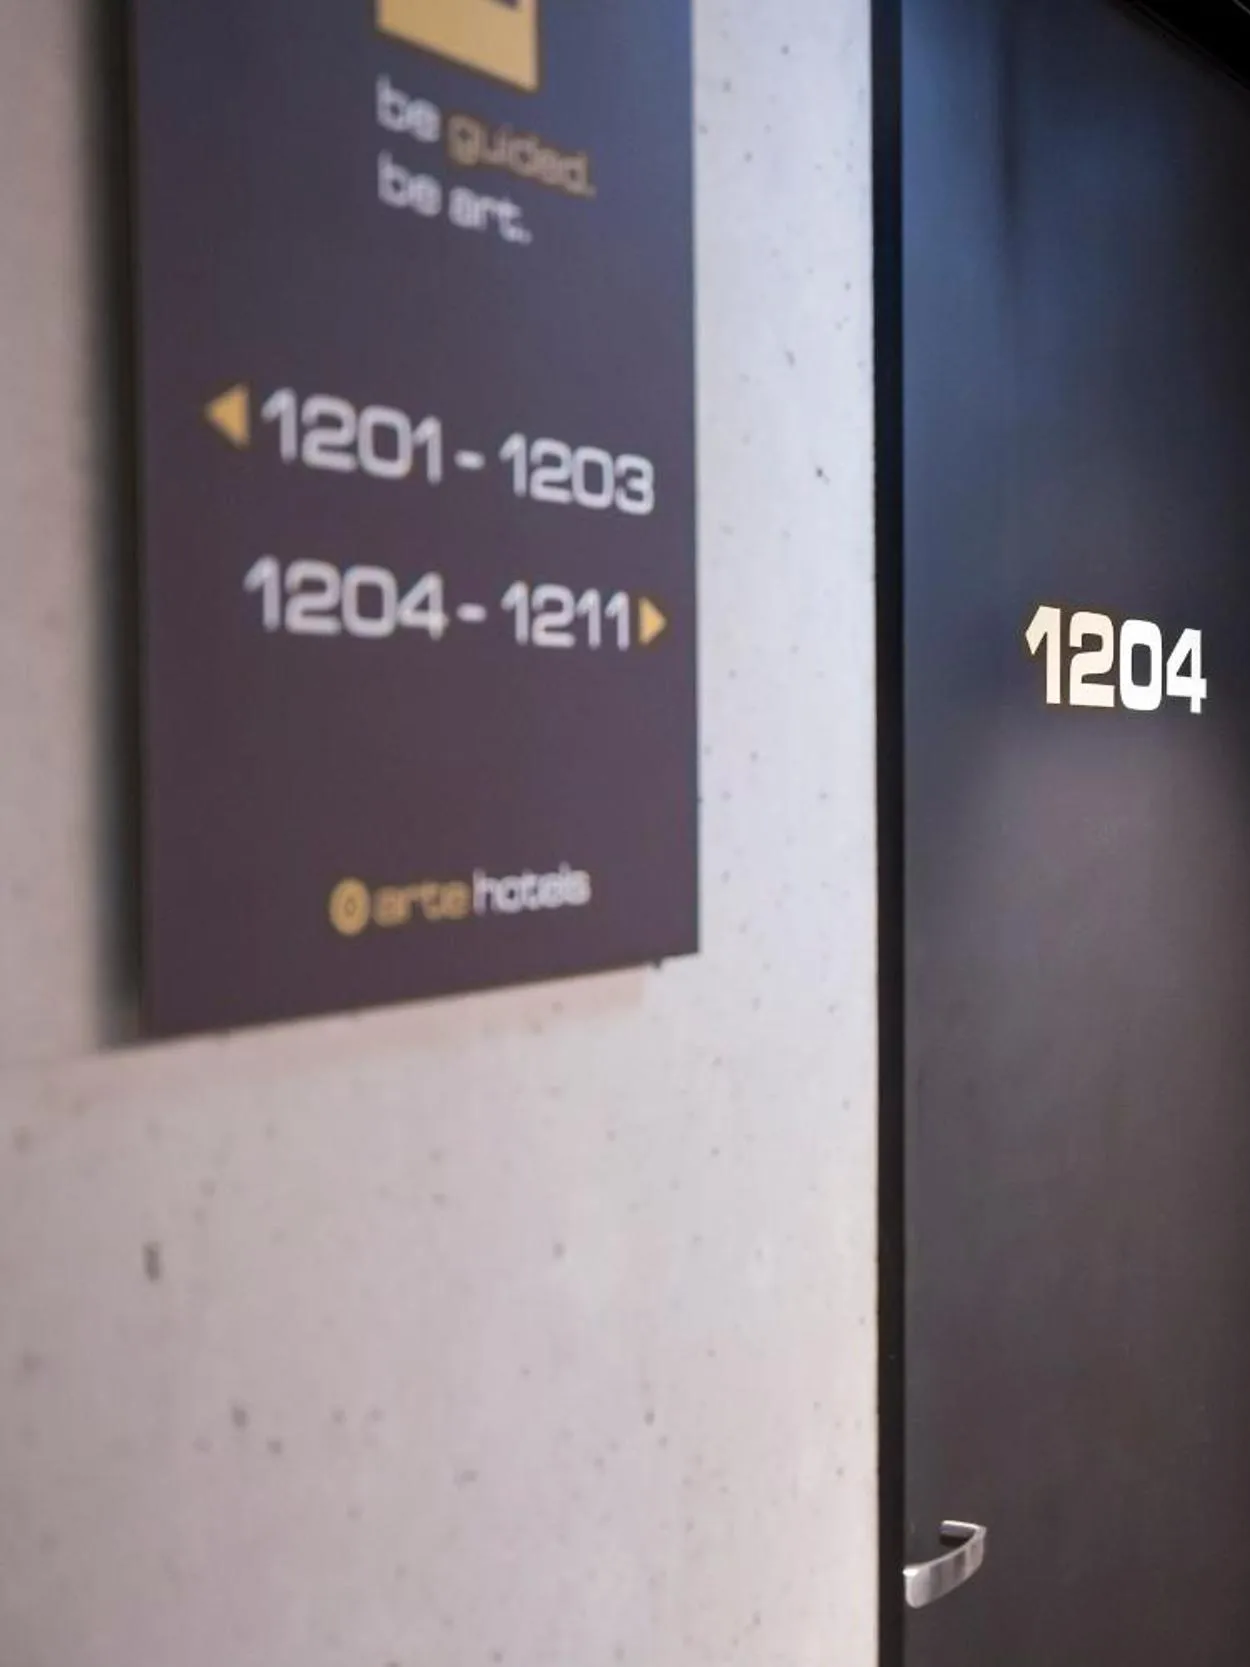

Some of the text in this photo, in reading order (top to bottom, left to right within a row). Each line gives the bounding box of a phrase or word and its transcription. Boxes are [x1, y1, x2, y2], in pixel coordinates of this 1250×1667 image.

[376, 73, 441, 143] be
[377, 150, 442, 217] be
[261, 387, 655, 516] 1201 - 1203
[243, 555, 630, 651] 1204 - 1211
[1025, 605, 1207, 714] 1204
[473, 861, 592, 917] hotels
